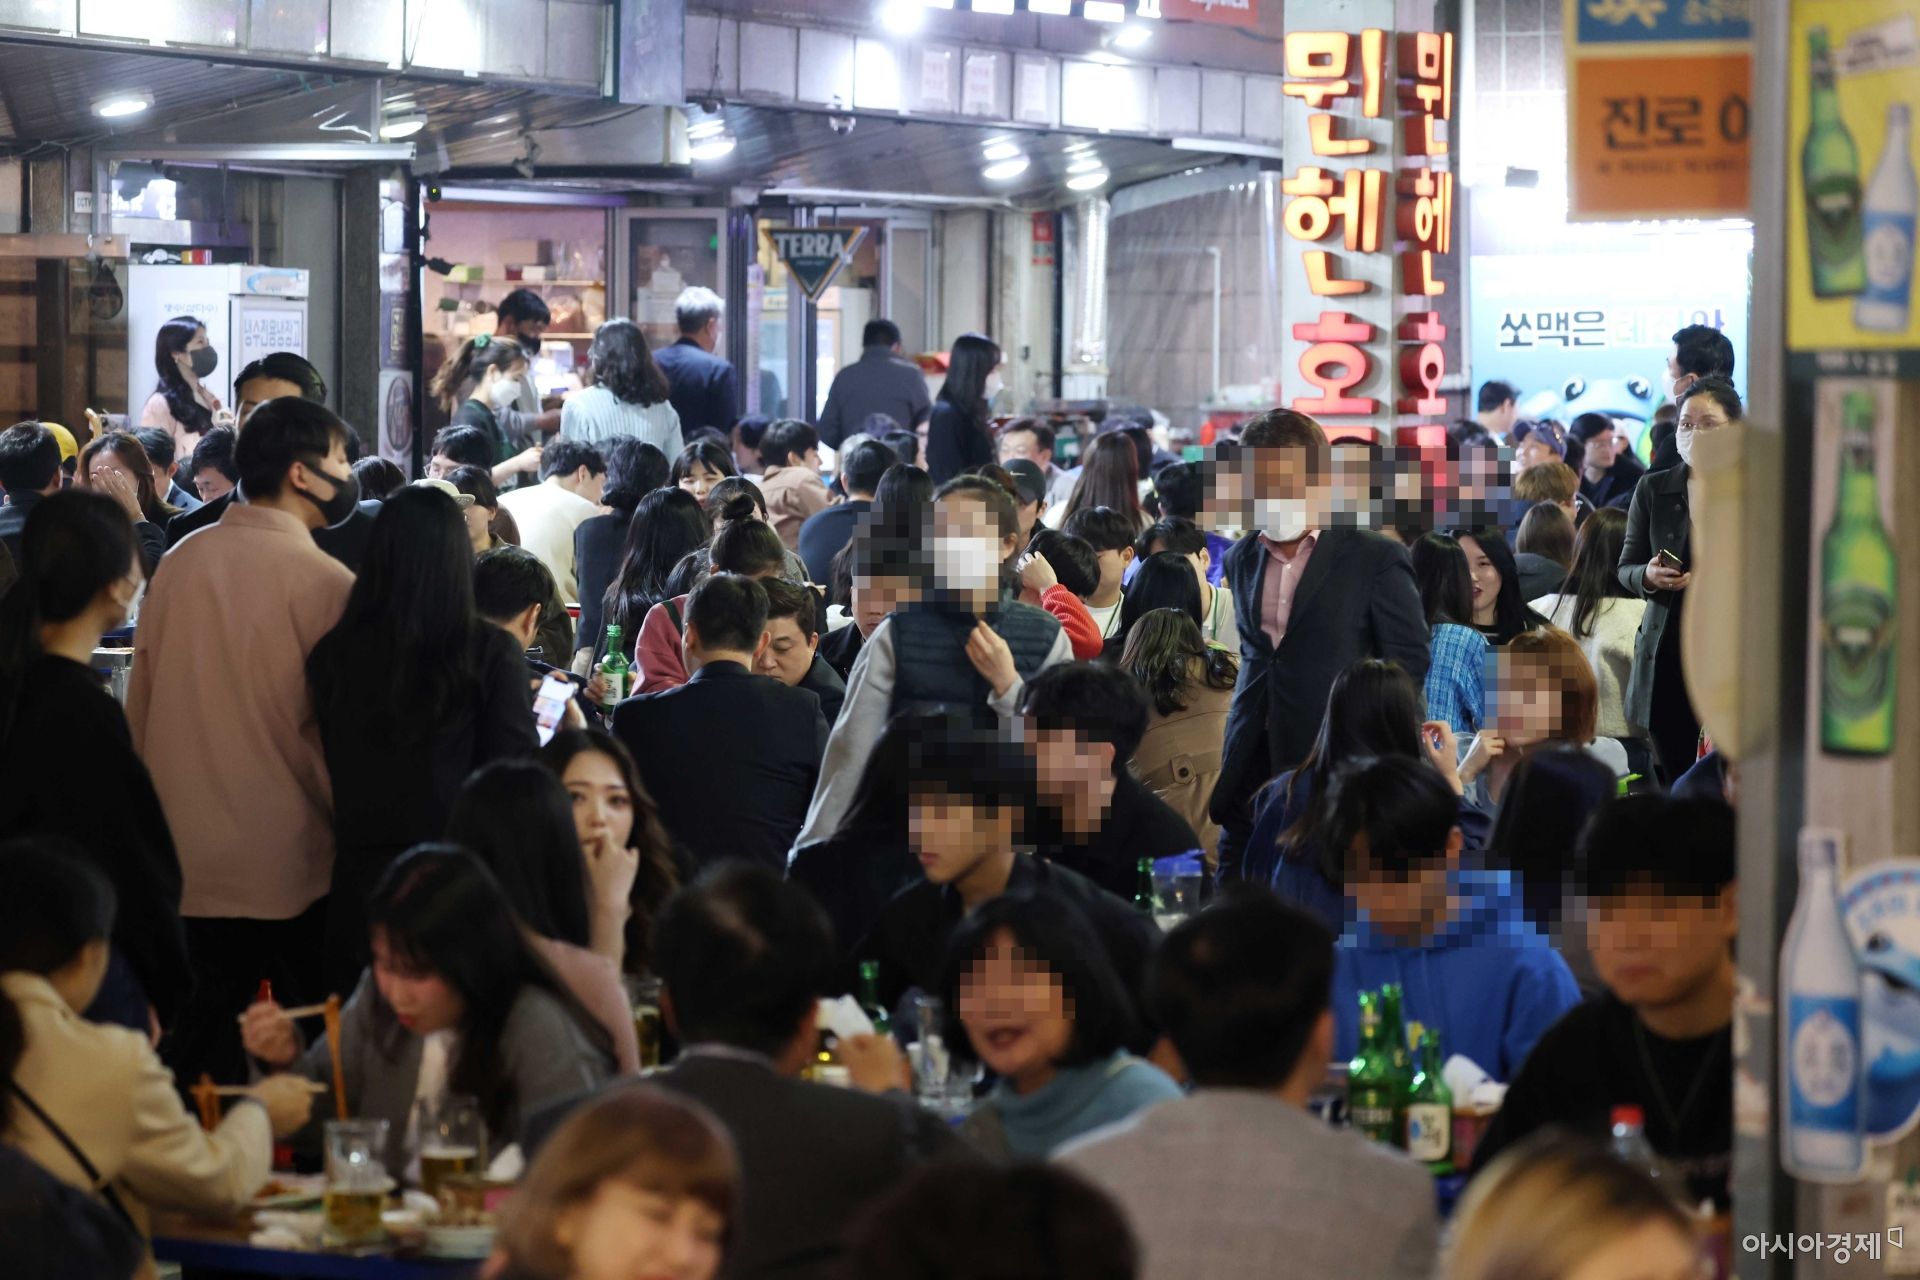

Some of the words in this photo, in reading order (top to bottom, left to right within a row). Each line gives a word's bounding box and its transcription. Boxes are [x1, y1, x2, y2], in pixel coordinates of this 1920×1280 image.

[1604, 96, 1704, 151] 진로
[774, 233, 844, 257] TERRA
[1500, 311, 1605, 346] 쏘맥은
